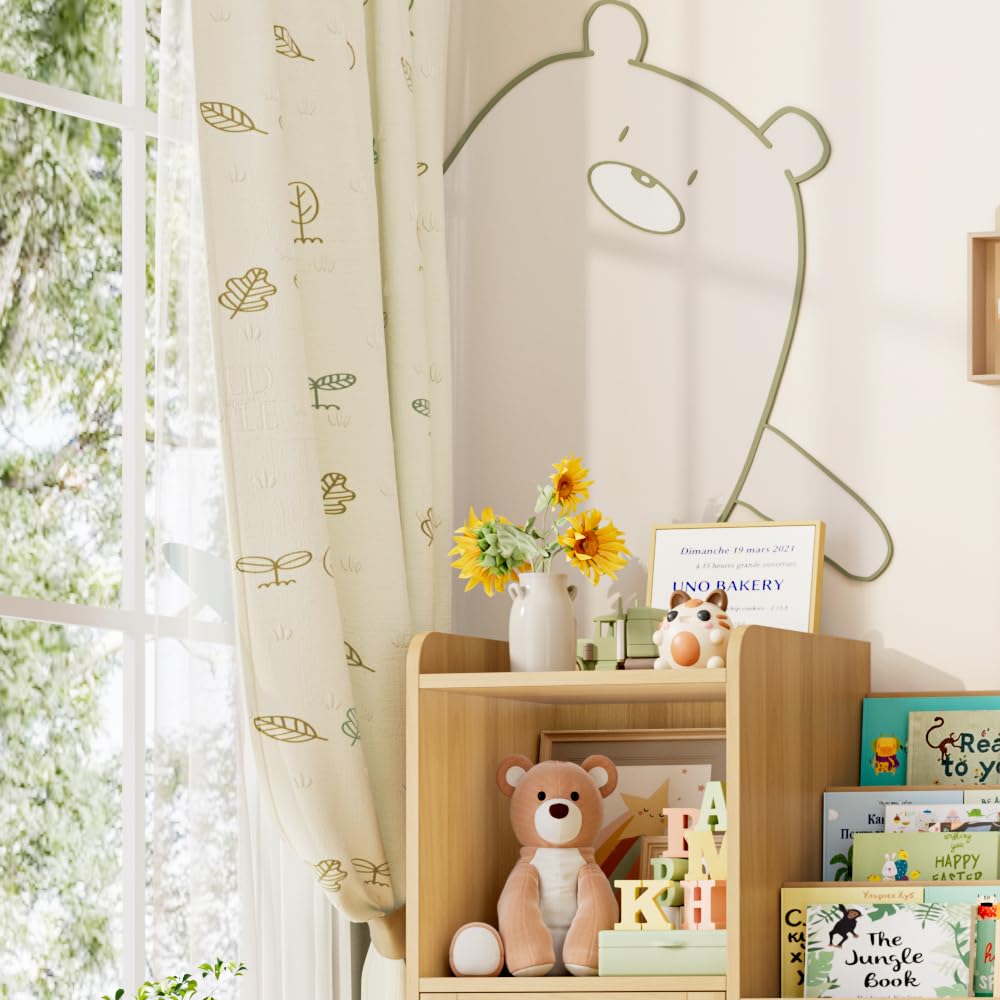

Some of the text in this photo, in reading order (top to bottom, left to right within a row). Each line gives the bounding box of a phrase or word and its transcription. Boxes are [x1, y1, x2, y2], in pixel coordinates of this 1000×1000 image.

[680, 546, 730, 556] Dimanche
[734, 546, 744, 554] 19
[746, 546, 770, 554] mars
[673, 579, 784, 593] UNO BAKERY
[942, 755, 969, 777] to
[694, 781, 728, 832] A
[935, 853, 981, 869] HAPPY
[614, 880, 675, 930] K
[681, 880, 717, 930] H
[867, 931, 903, 947] The
[845, 947, 924, 972] Jungle
[864, 970, 920, 988] Book
